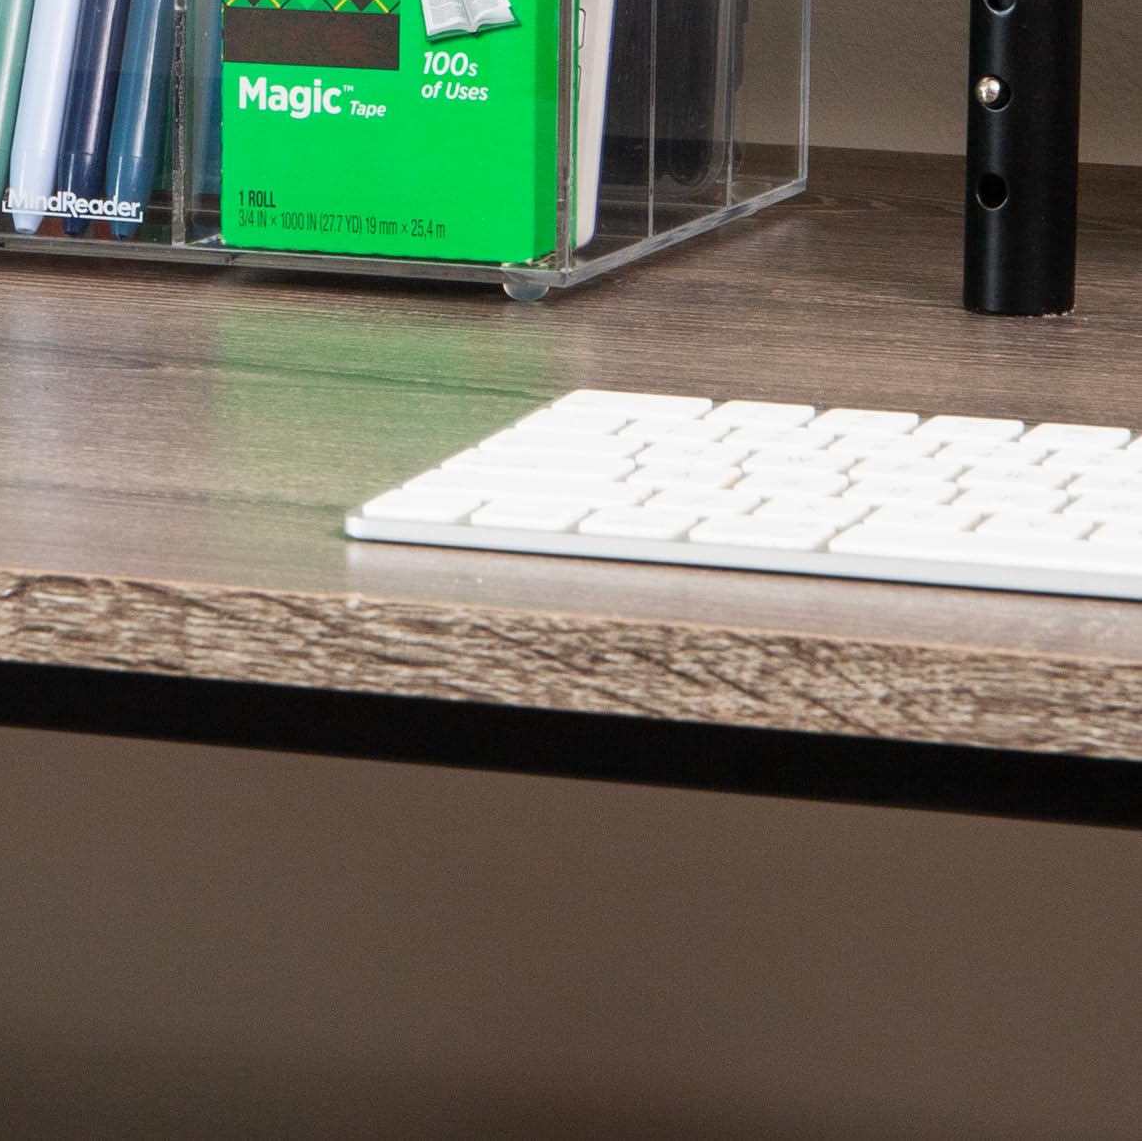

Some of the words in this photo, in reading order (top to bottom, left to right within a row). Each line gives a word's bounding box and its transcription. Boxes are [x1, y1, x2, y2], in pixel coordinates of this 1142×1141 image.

[423, 51, 478, 77] 100s
[421, 81, 443, 99] of
[445, 82, 489, 101] Uses
[350, 100, 386, 118] Tape
[7, 188, 141, 218] MindReader
[239, 190, 245, 206] 1
[248, 190, 276, 208] ROLL
[238, 210, 255, 227] 3/4
[257, 210, 267, 228] IN
[280, 212, 305, 231] 1000
[307, 212, 317, 231] IN
[319, 212, 343, 234] (27.7
[345, 214, 363, 235] YD)
[365, 216, 376, 235] 19
[379, 220, 398, 235] mm
[411, 219, 434, 240] 25,4
[436, 223, 446, 238] m
